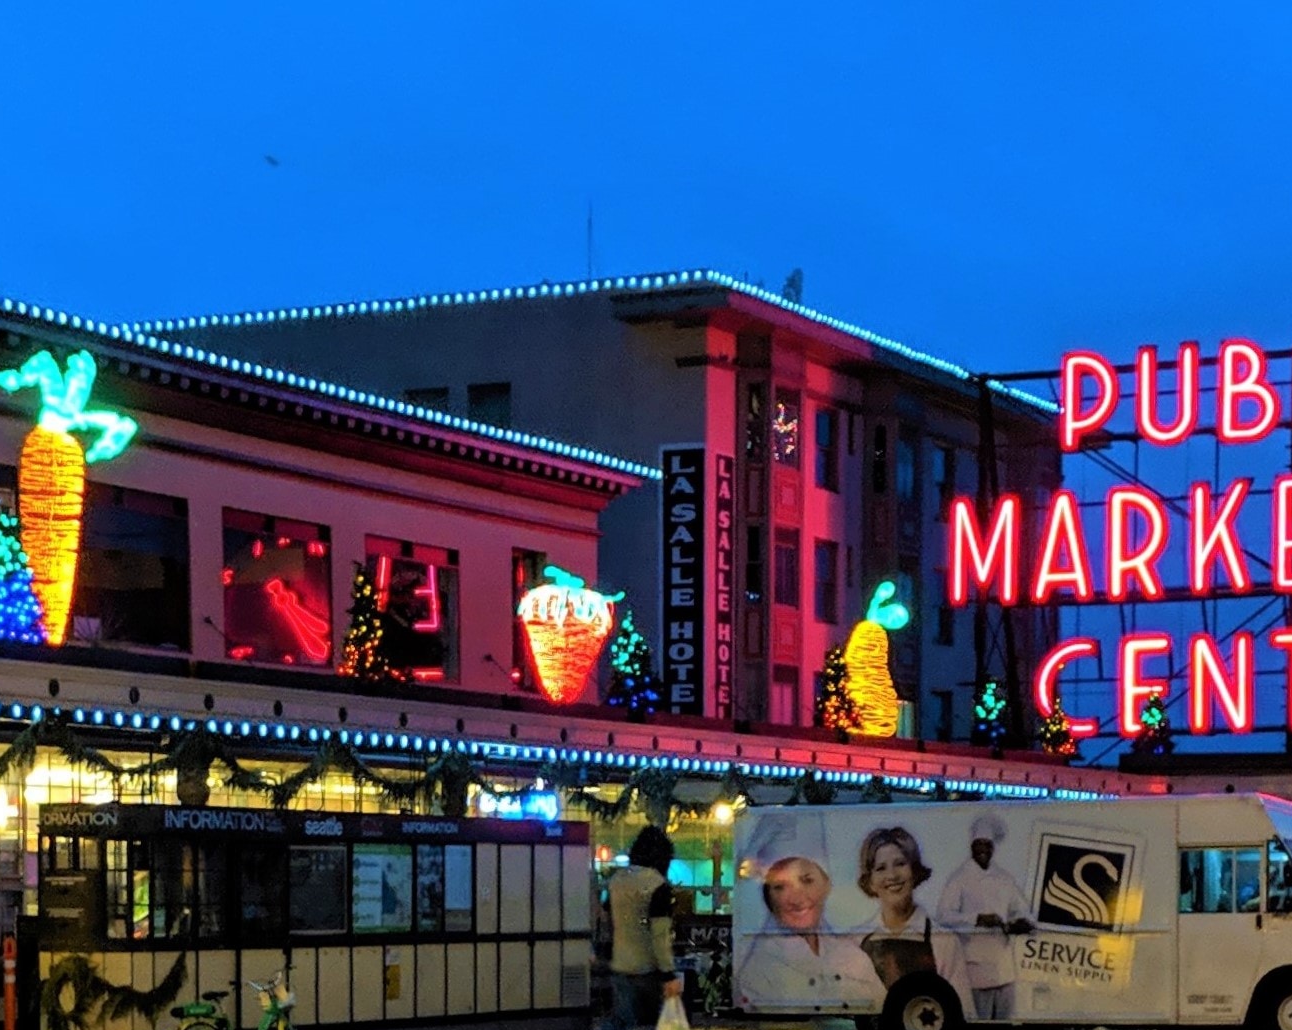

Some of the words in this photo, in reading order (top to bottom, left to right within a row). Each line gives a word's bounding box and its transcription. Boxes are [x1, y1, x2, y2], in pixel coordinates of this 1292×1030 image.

[669, 456, 696, 495] LA
[718, 459, 731, 500] LA
[668, 503, 697, 607] SALLE
[718, 510, 731, 612] SALLE
[164, 809, 265, 831] INFORMATION
[305, 816, 344, 836] seattle
[401, 821, 457, 835] INFORMATION
[1022, 939, 1116, 971] SERVICE
[1020, 960, 1059, 974] LINEN
[1067, 966, 1114, 983] SUPPLY
